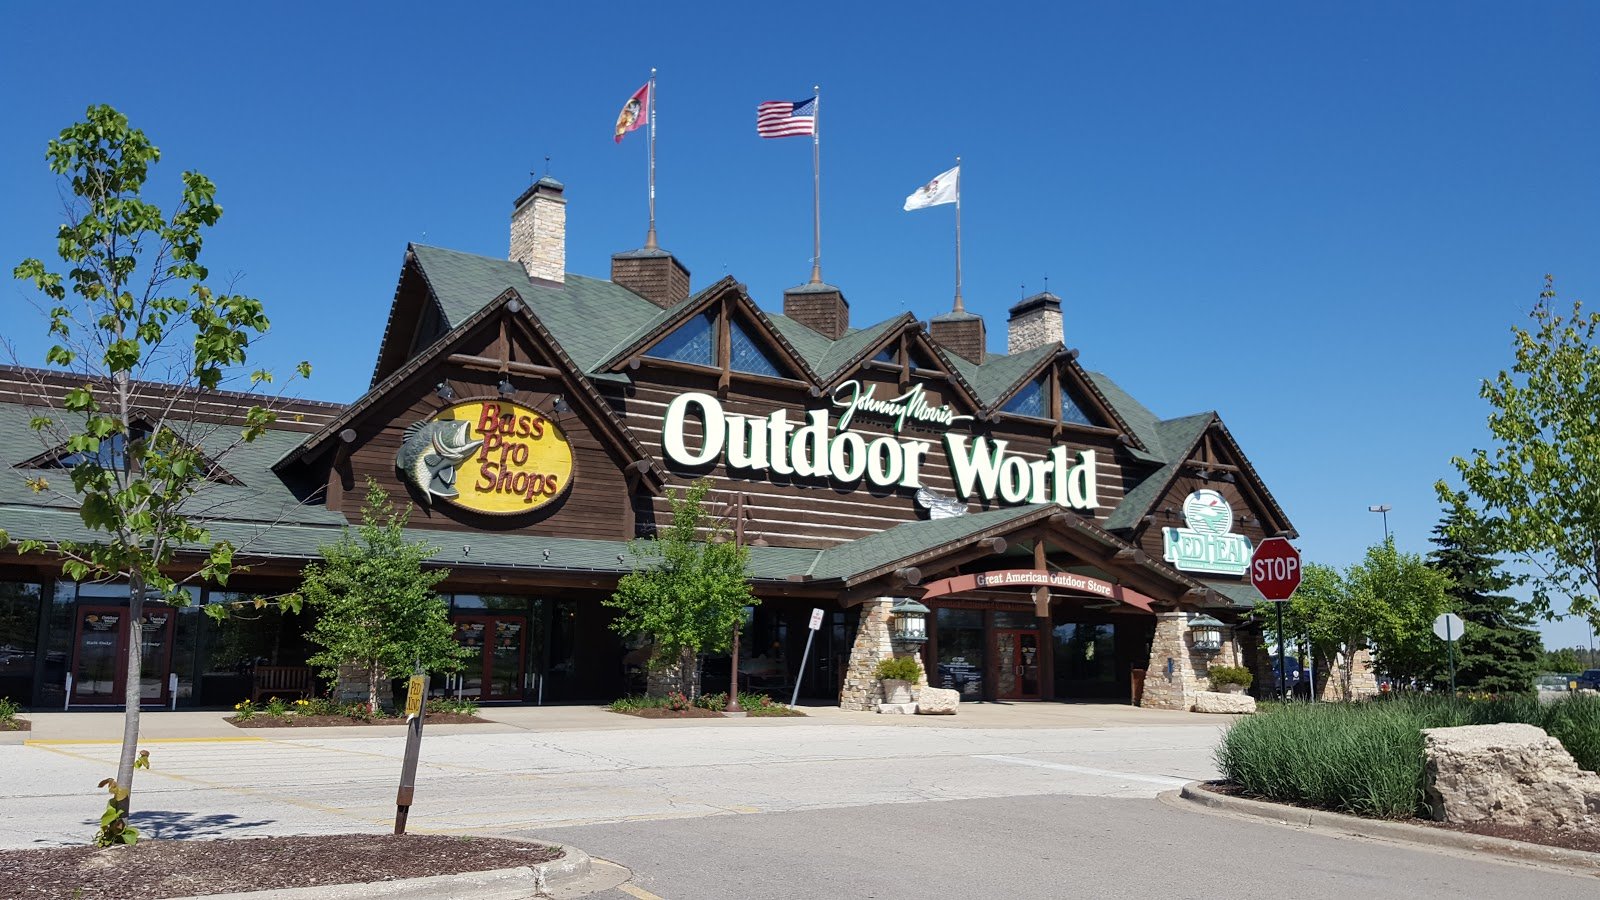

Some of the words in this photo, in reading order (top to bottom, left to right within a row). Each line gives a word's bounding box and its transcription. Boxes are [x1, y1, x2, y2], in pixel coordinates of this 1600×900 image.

[477, 402, 544, 438] Bass
[832, 380, 906, 432] Johnny
[890, 383, 975, 425] Morris
[477, 432, 529, 466] Pro
[662, 392, 930, 488] Outdoor
[943, 432, 1100, 509] World
[475, 462, 557, 503] Shops
[977, 573, 1003, 586] Great
[1005, 571, 1048, 584] American
[1050, 573, 1086, 589] Outdoor
[1087, 580, 1111, 595] Store
[1254, 557, 1298, 582] STOP
[407, 696, 421, 712] XING
[411, 680, 421, 695] PED
